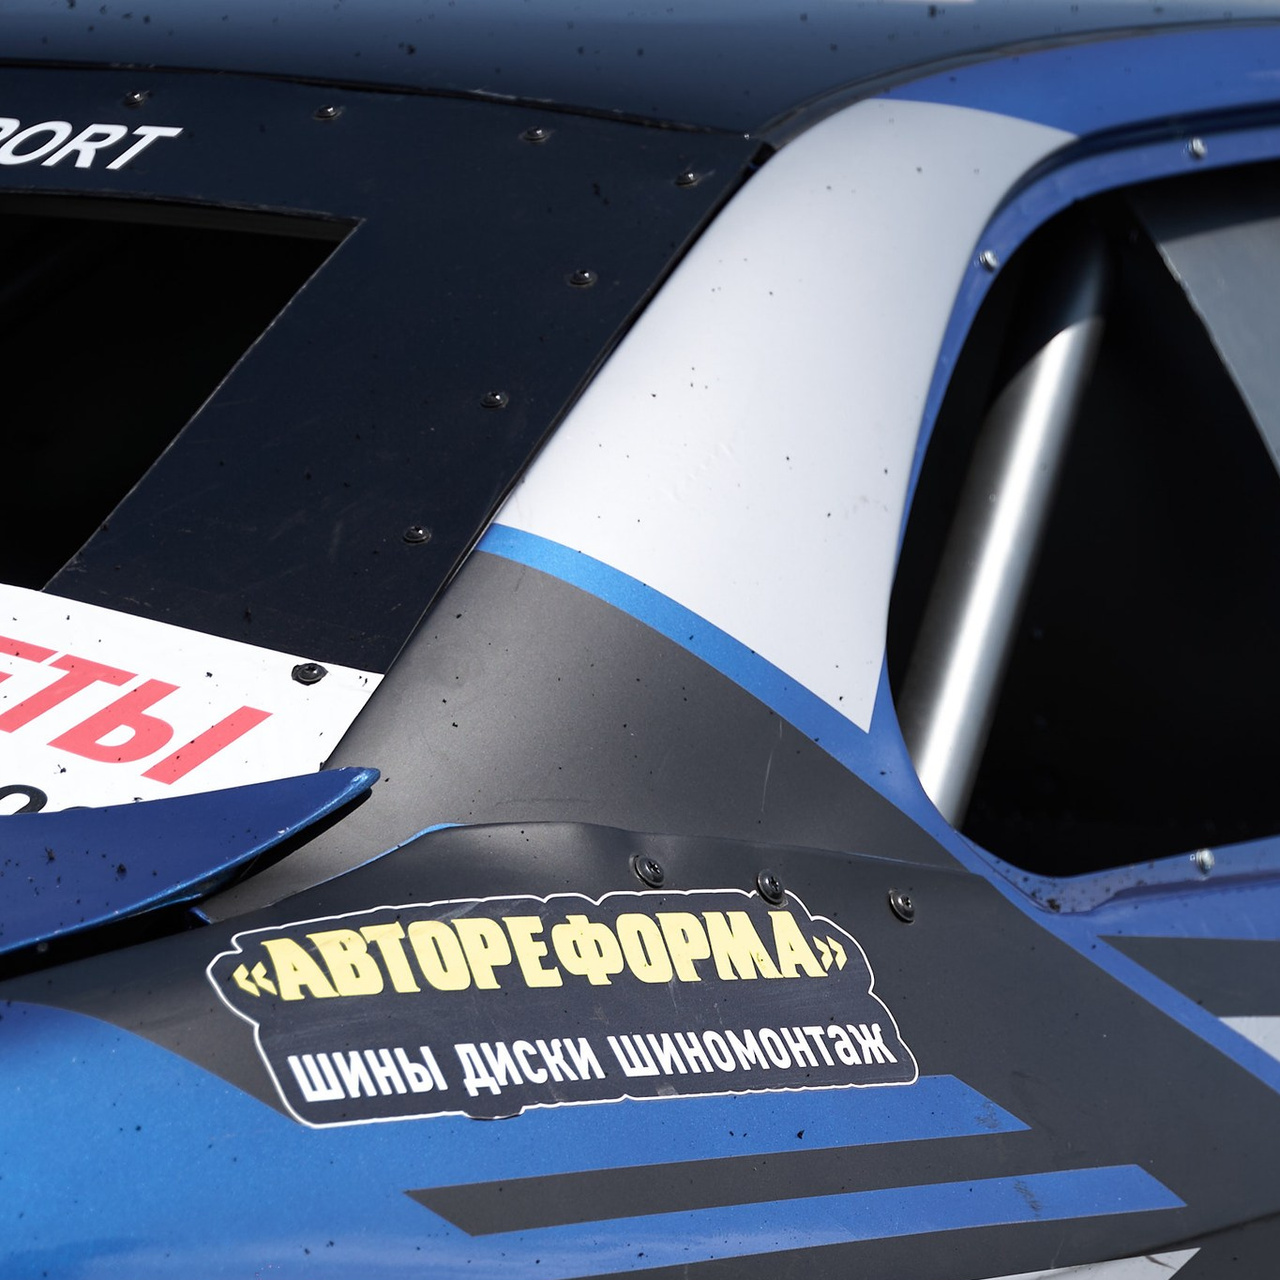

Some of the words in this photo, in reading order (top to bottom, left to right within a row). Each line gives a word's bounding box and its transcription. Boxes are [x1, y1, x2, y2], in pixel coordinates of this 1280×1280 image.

[286, 1044, 449, 1103] ШИНЫ
[463, 1036, 601, 1096] ДИСКИ
[608, 1021, 899, 1078] ШИНОМОНТАЖ
